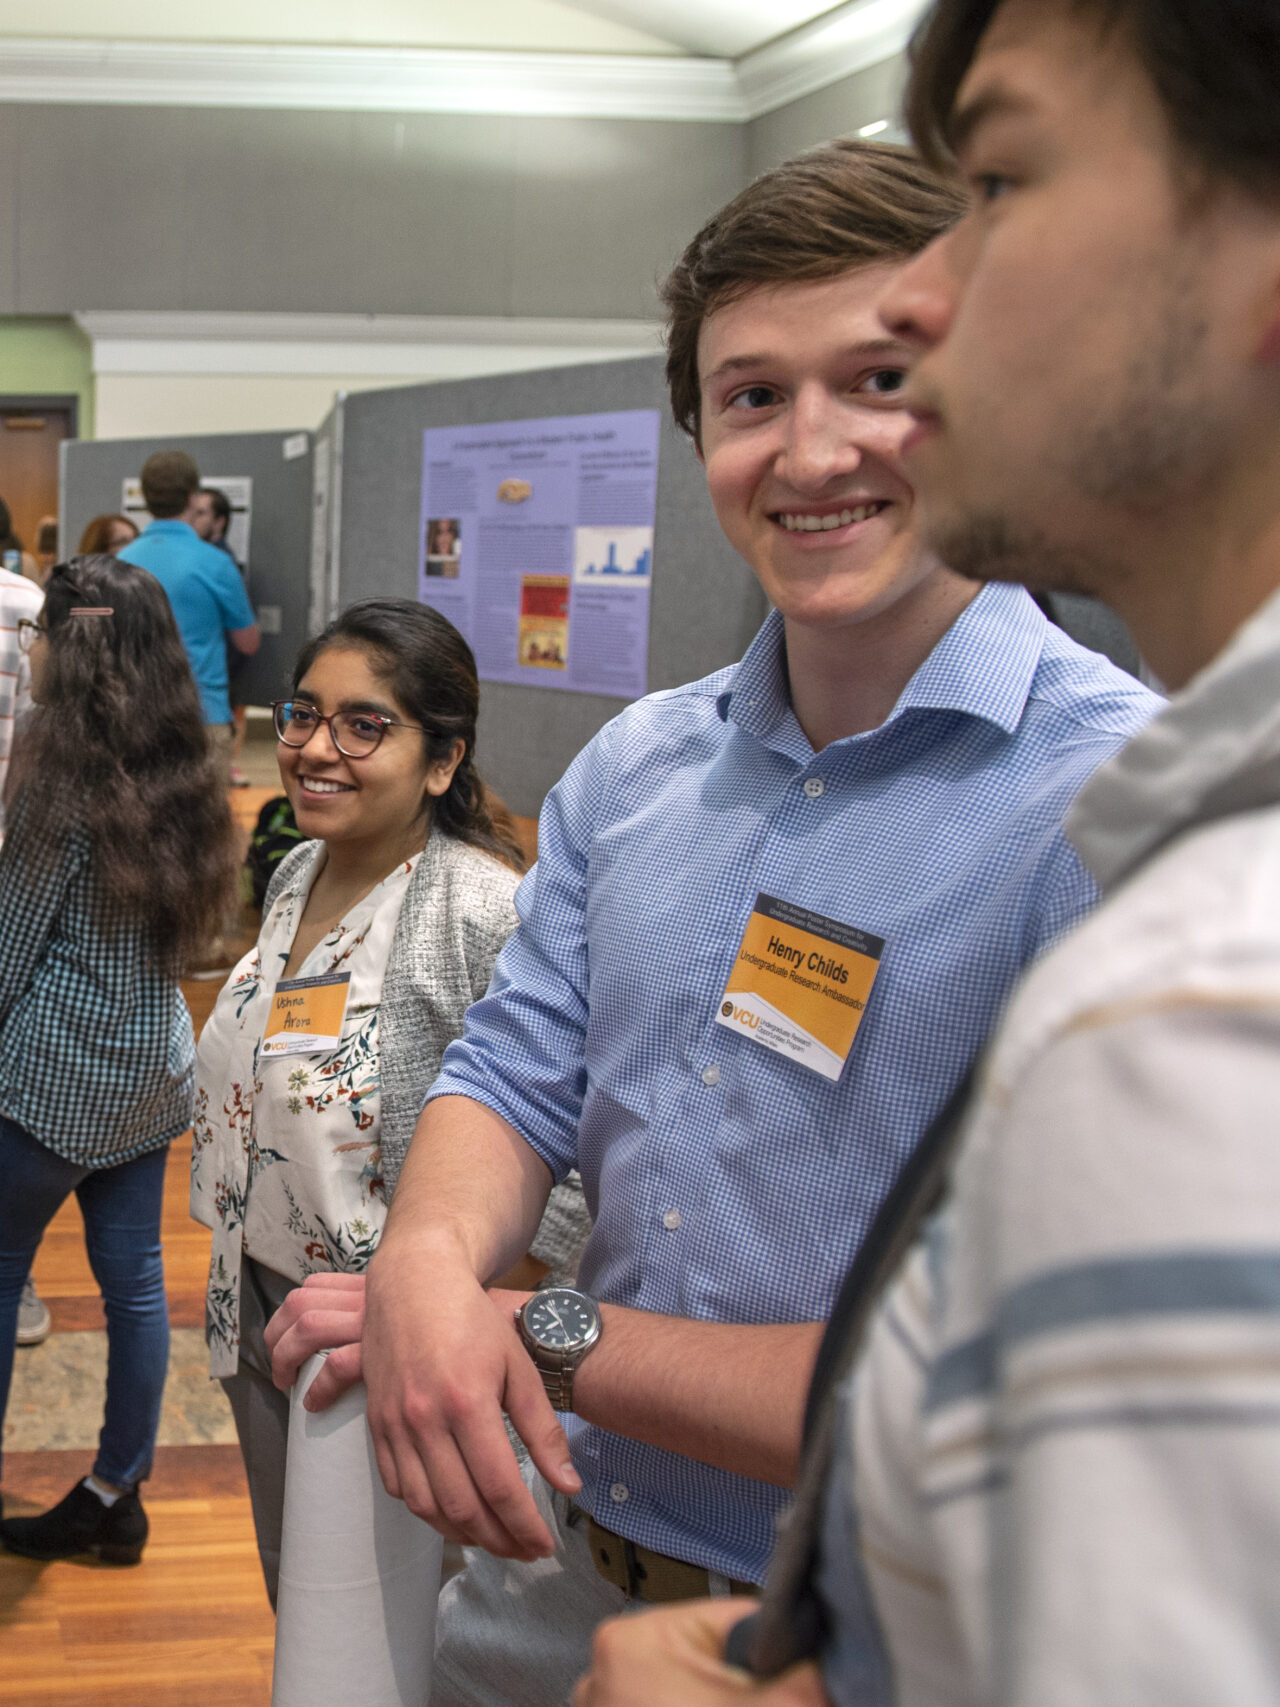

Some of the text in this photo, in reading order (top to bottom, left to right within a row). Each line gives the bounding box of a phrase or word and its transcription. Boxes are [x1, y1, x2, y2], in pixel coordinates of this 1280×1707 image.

[766, 935, 849, 985] Henry Childs
[740, 950, 866, 1011] Undergraduate Research Ambassador
[733, 1006, 760, 1029] VCU
[271, 1040, 288, 1051] VCU
